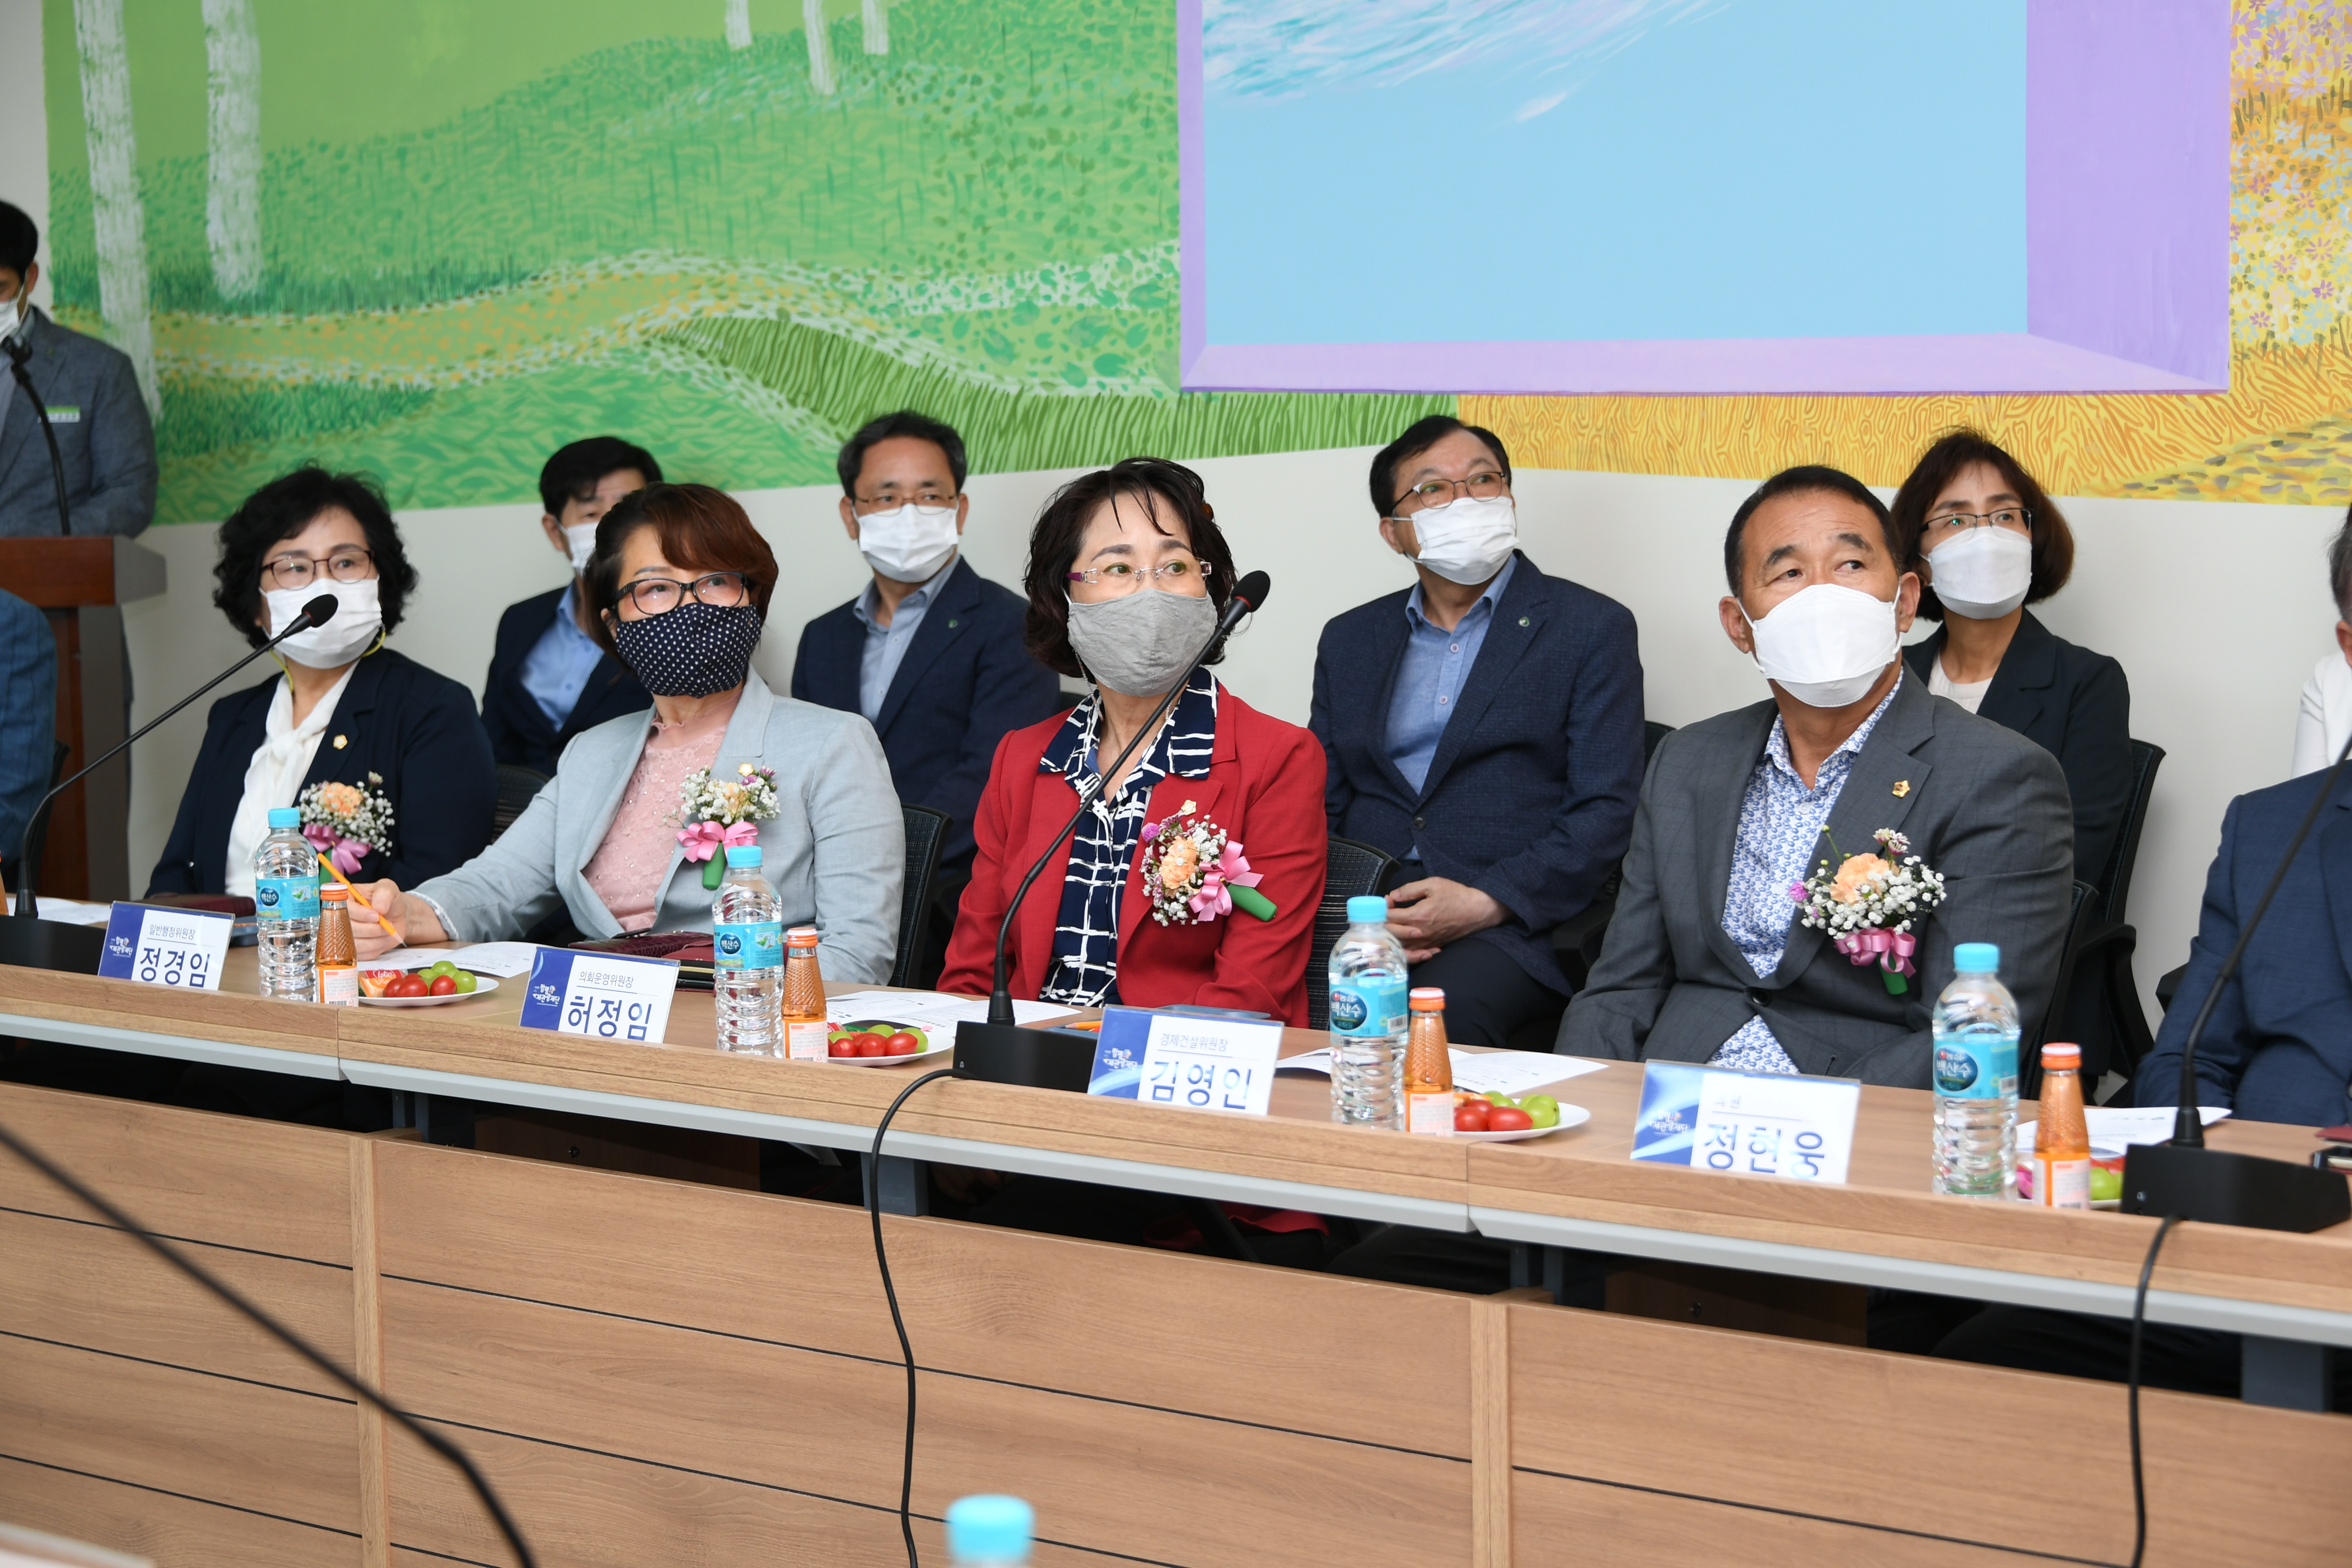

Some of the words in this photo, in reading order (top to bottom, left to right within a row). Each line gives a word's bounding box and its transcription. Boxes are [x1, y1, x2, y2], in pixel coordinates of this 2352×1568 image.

[261, 893, 277, 902] 백산수
[150, 924, 196, 940] 일반행정위원장
[721, 940, 739, 950] 백산수
[140, 947, 210, 988] 정경임
[579, 971, 634, 988] 의회운영위원장
[568, 995, 652, 1041] 허정임
[1331, 1001, 1362, 1018] 백산수
[1160, 1033, 1228, 1052] 경제건설위원장
[1936, 1059, 1971, 1078] 백산수
[1150, 1061, 1252, 1110] 김영인
[1703, 1124, 1825, 1180] 정현웅
